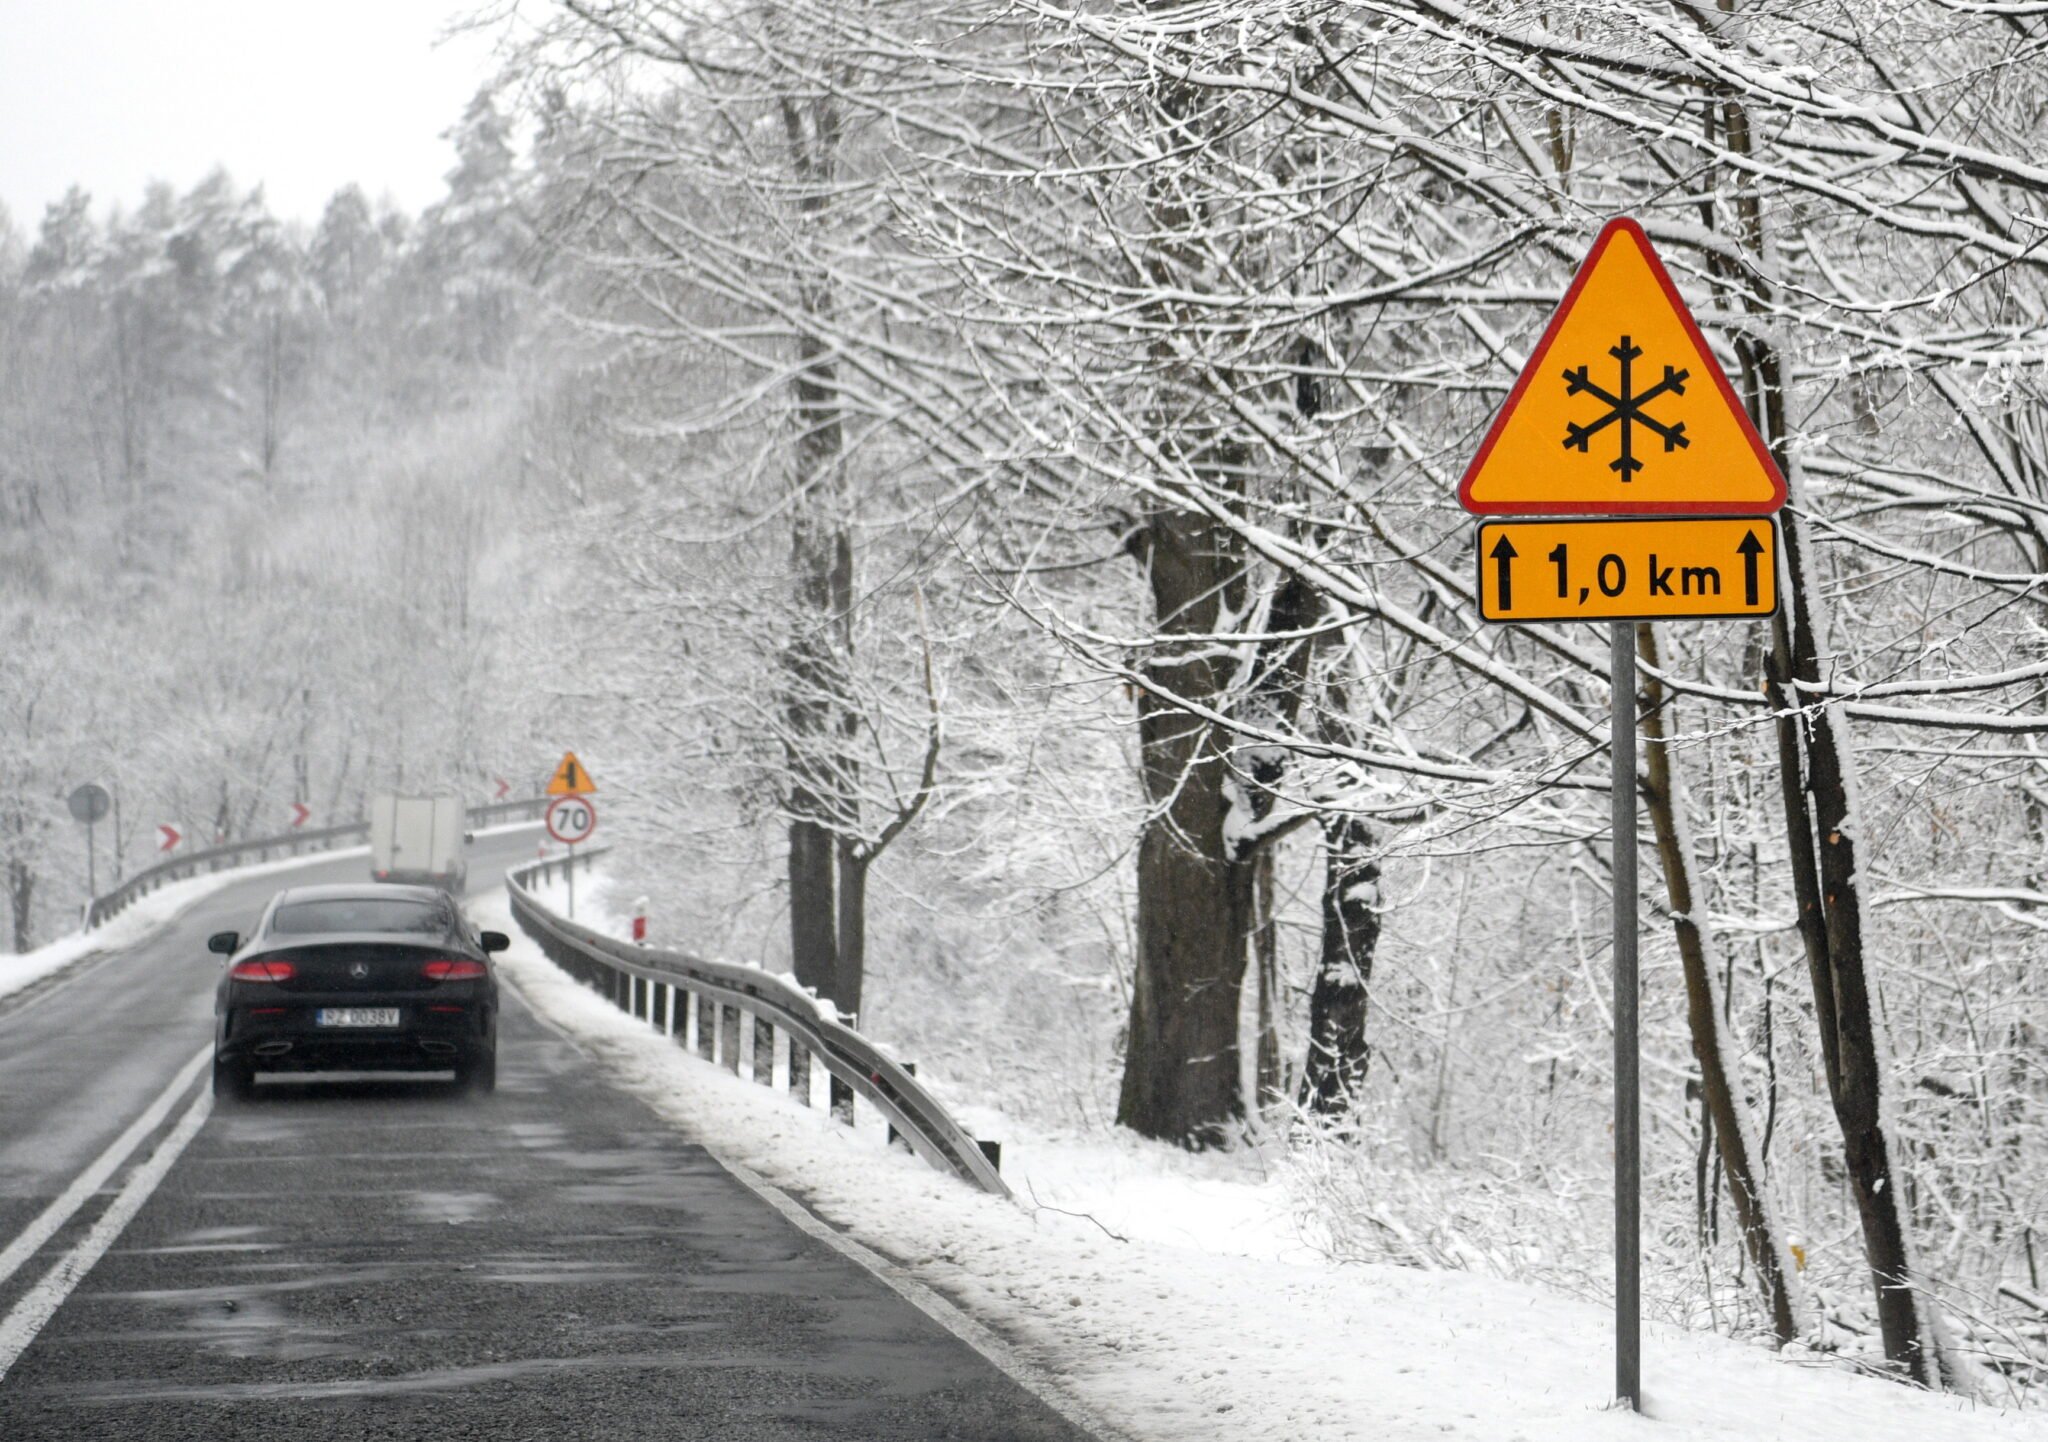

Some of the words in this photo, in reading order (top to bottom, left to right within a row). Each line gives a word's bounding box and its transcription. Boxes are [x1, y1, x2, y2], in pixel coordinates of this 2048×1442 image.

[1549, 543, 1627, 606] 1,0
[1649, 553, 1721, 596] km
[556, 807, 589, 831] 70
